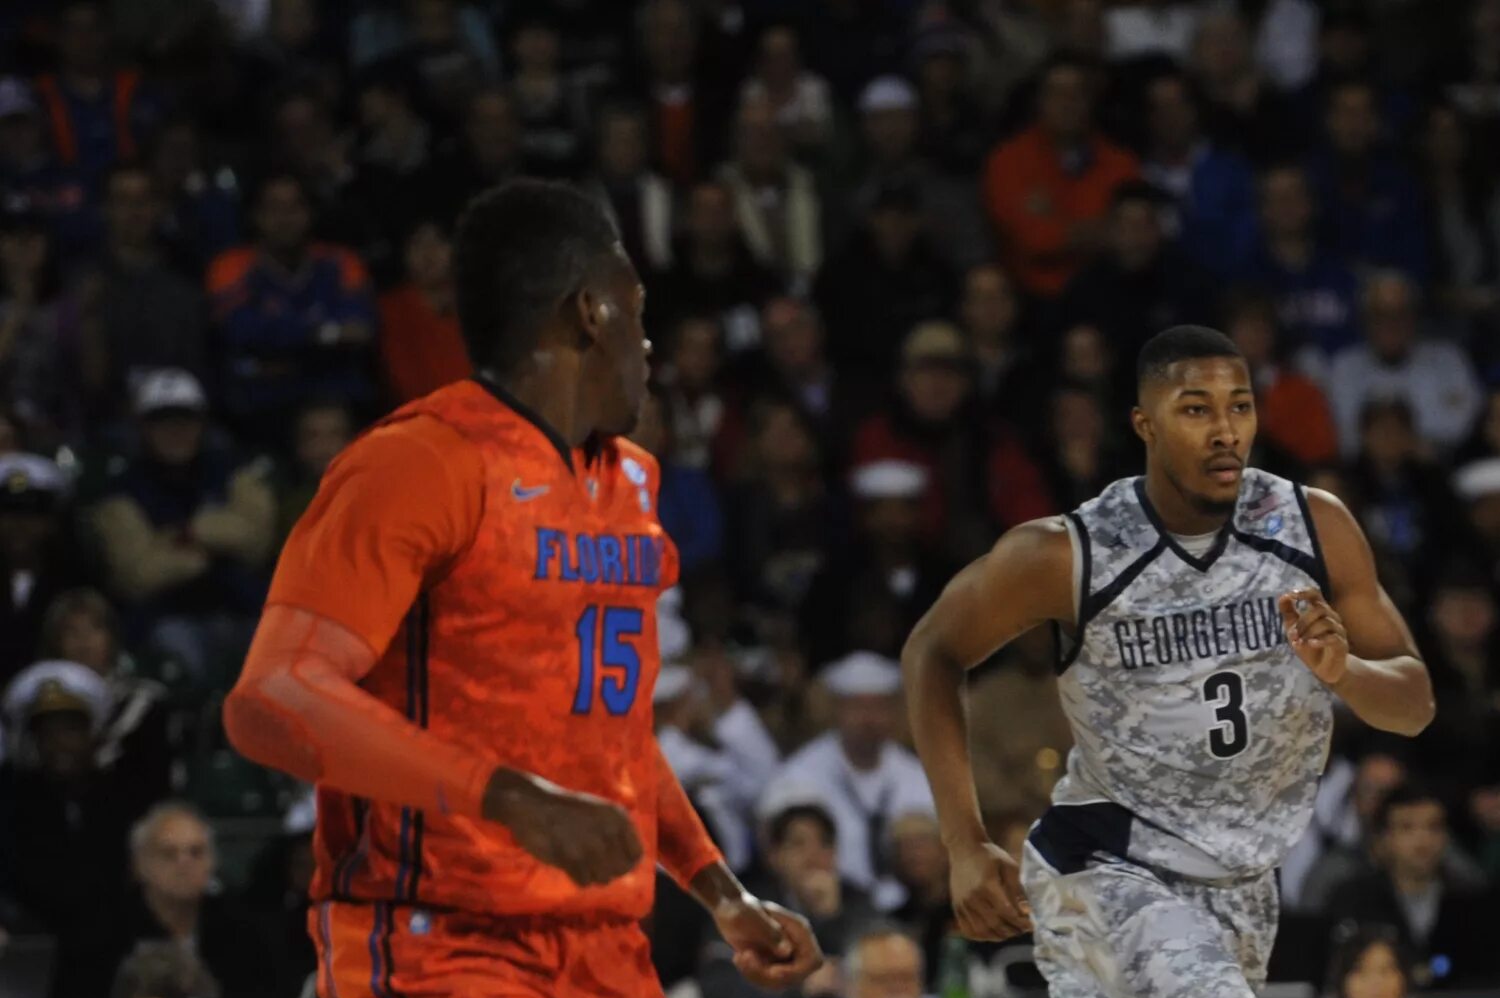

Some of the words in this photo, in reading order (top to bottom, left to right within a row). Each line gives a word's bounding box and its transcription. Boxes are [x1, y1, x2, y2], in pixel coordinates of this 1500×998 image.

[534, 527, 664, 587] FLORID
[572, 604, 644, 716] 15
[1114, 597, 1287, 670] GEORGETOW
[1202, 669, 1250, 760] 3
